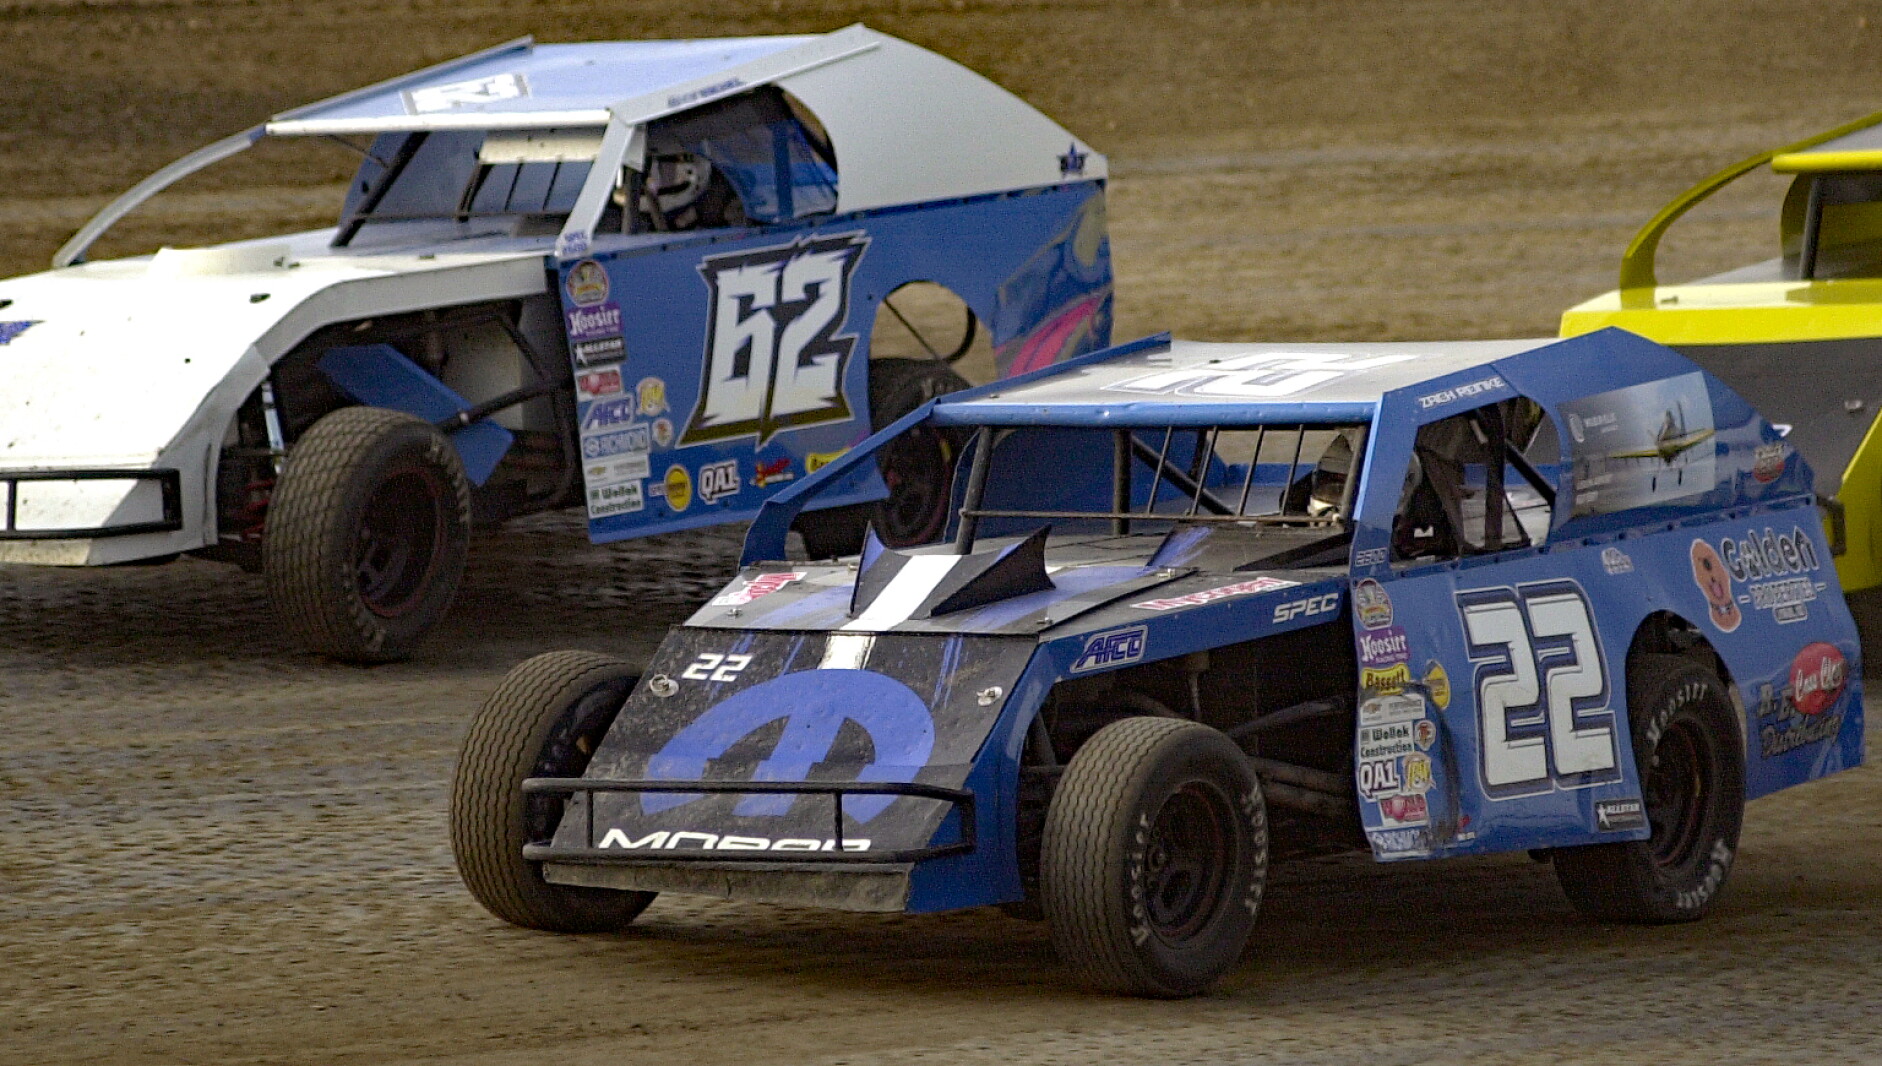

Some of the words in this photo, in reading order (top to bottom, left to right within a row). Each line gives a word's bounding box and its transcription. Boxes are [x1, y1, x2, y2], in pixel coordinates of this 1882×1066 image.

[700, 248, 848, 430] 62
[701, 462, 738, 501] QA1
[1272, 592, 1339, 624] SPEC
[682, 653, 752, 682] 22
[1460, 588, 1618, 792] 22
[1360, 758, 1399, 797] QA1
